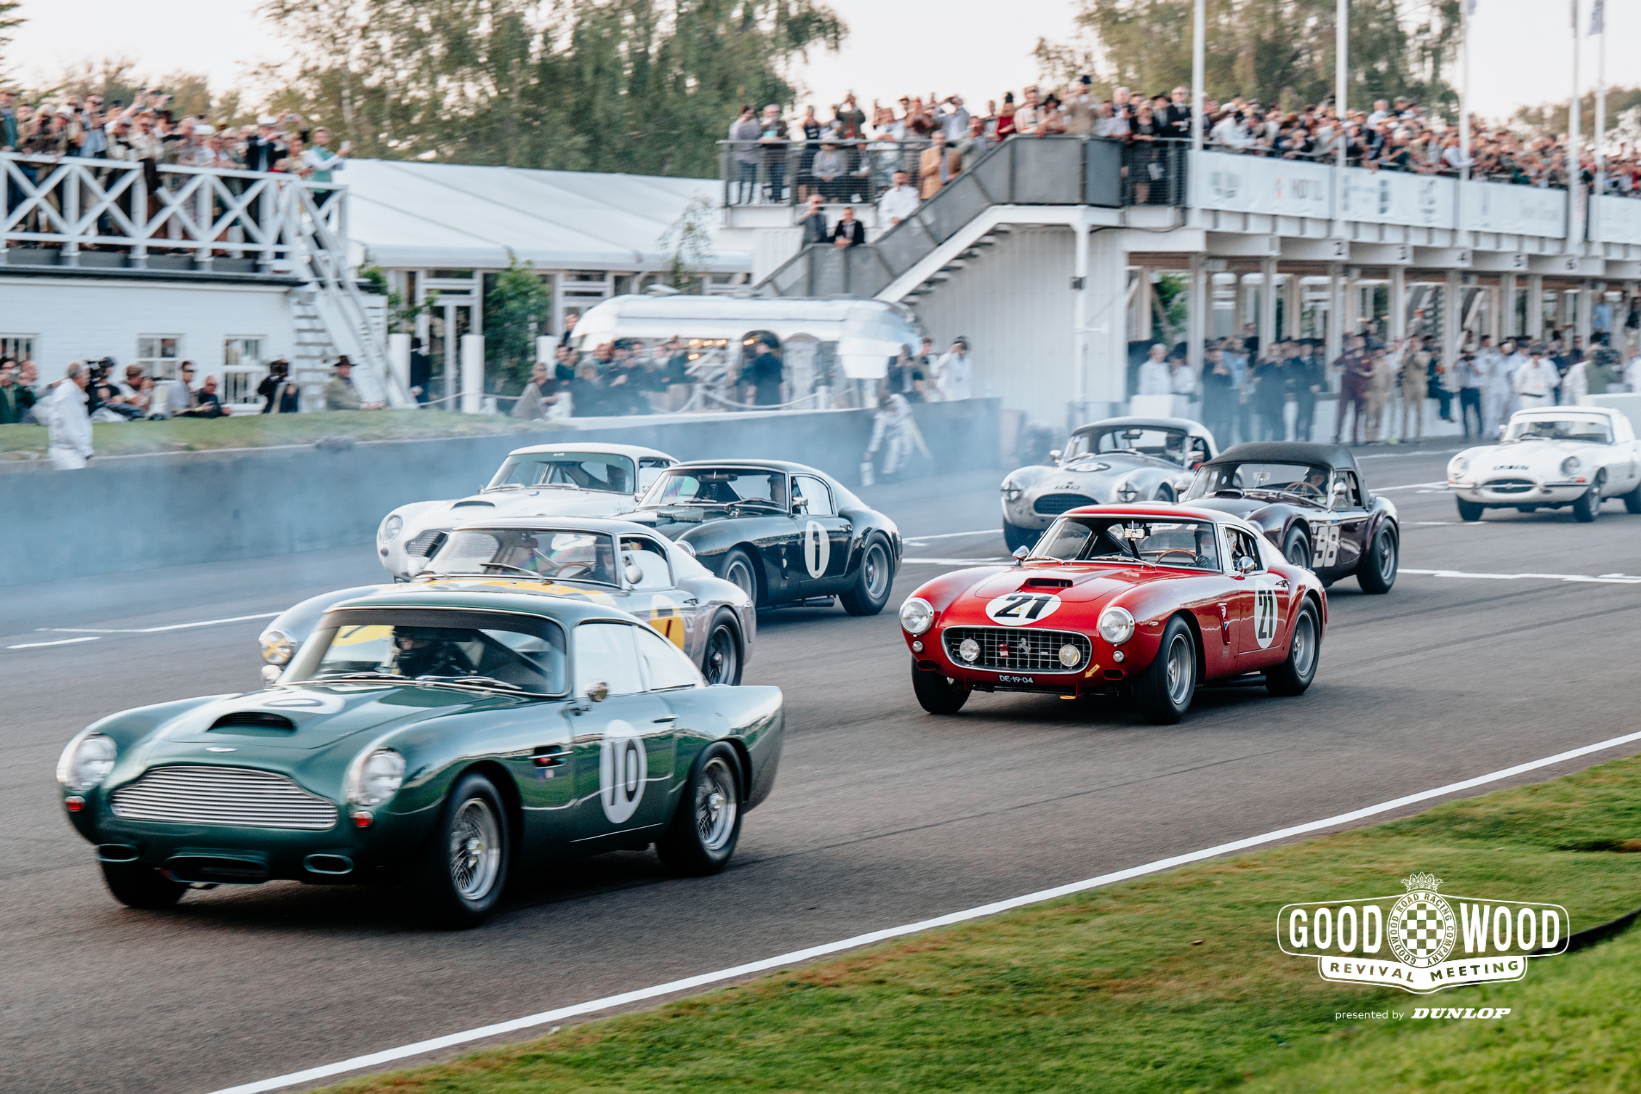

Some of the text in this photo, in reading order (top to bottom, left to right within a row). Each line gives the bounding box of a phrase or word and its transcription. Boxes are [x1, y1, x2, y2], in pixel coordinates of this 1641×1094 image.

[1334, 241, 1343, 256] 2
[811, 523, 820, 572] 1
[1312, 526, 1340, 568] 98
[993, 595, 1053, 620] 21
[1258, 588, 1274, 640] 21
[609, 738, 640, 807] 10
